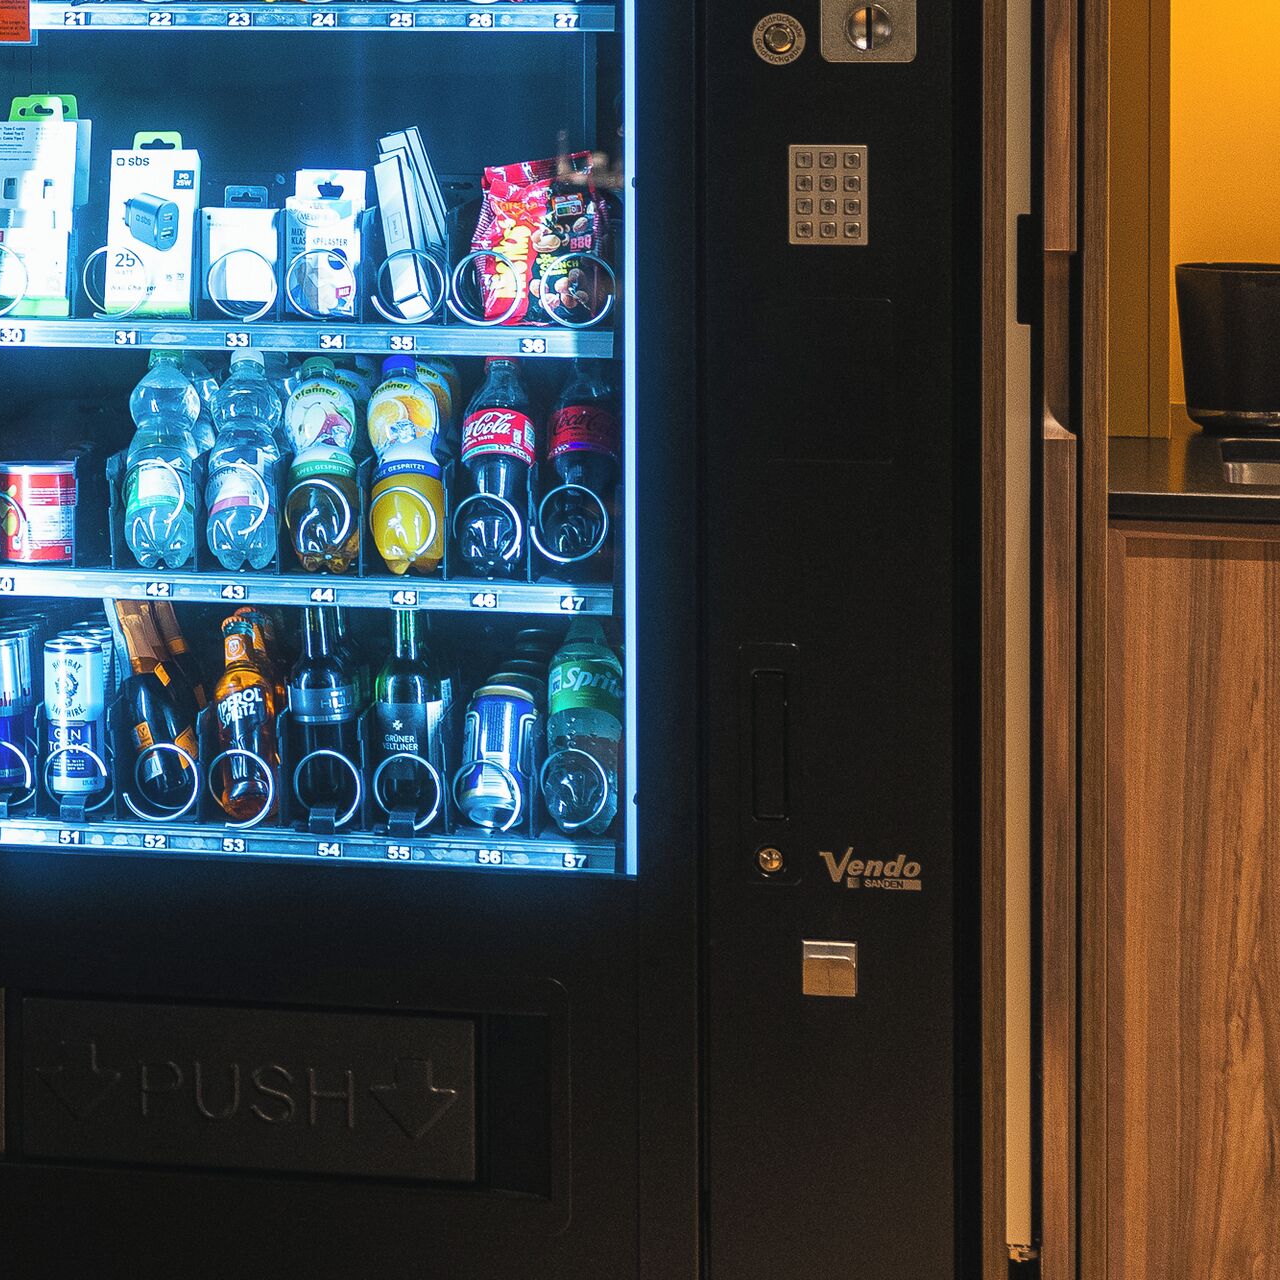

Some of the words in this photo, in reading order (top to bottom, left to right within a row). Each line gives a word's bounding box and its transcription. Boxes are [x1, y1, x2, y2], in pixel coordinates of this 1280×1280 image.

[65, 13, 85, 25] 21
[149, 13, 172, 25] 22
[228, 13, 251, 26] 23
[312, 13, 335, 26] 24
[390, 13, 412, 26] 25
[469, 13, 492, 26] 26
[555, 14, 578, 27] 27
[128, 156, 150, 166] sbs
[570, 235, 592, 248] BBQ
[115, 253, 136, 267] 25
[0, 329, 24, 342] 30
[115, 332, 136, 344] 31
[226, 333, 248, 346] 33
[320, 335, 342, 348] 34
[390, 337, 413, 350] 35
[521, 339, 545, 352] 36
[146, 583, 169, 596] 42
[222, 585, 245, 598] 43
[311, 589, 333, 602] 44
[393, 592, 416, 605] 45
[472, 594, 496, 607] 46
[561, 597, 585, 610] 47
[384, 733, 415, 743] GRÜNER
[59, 831, 79, 843] 51
[144, 834, 166, 847] 52
[222, 838, 244, 851] 53
[317, 843, 339, 856] 54
[388, 846, 410, 860] 55
[478, 850, 501, 864] 56
[564, 854, 586, 867] 57
[818, 846, 922, 883] Vendo
[863, 879, 904, 889] SANDEN
[139, 1059, 355, 1128] PUSH
